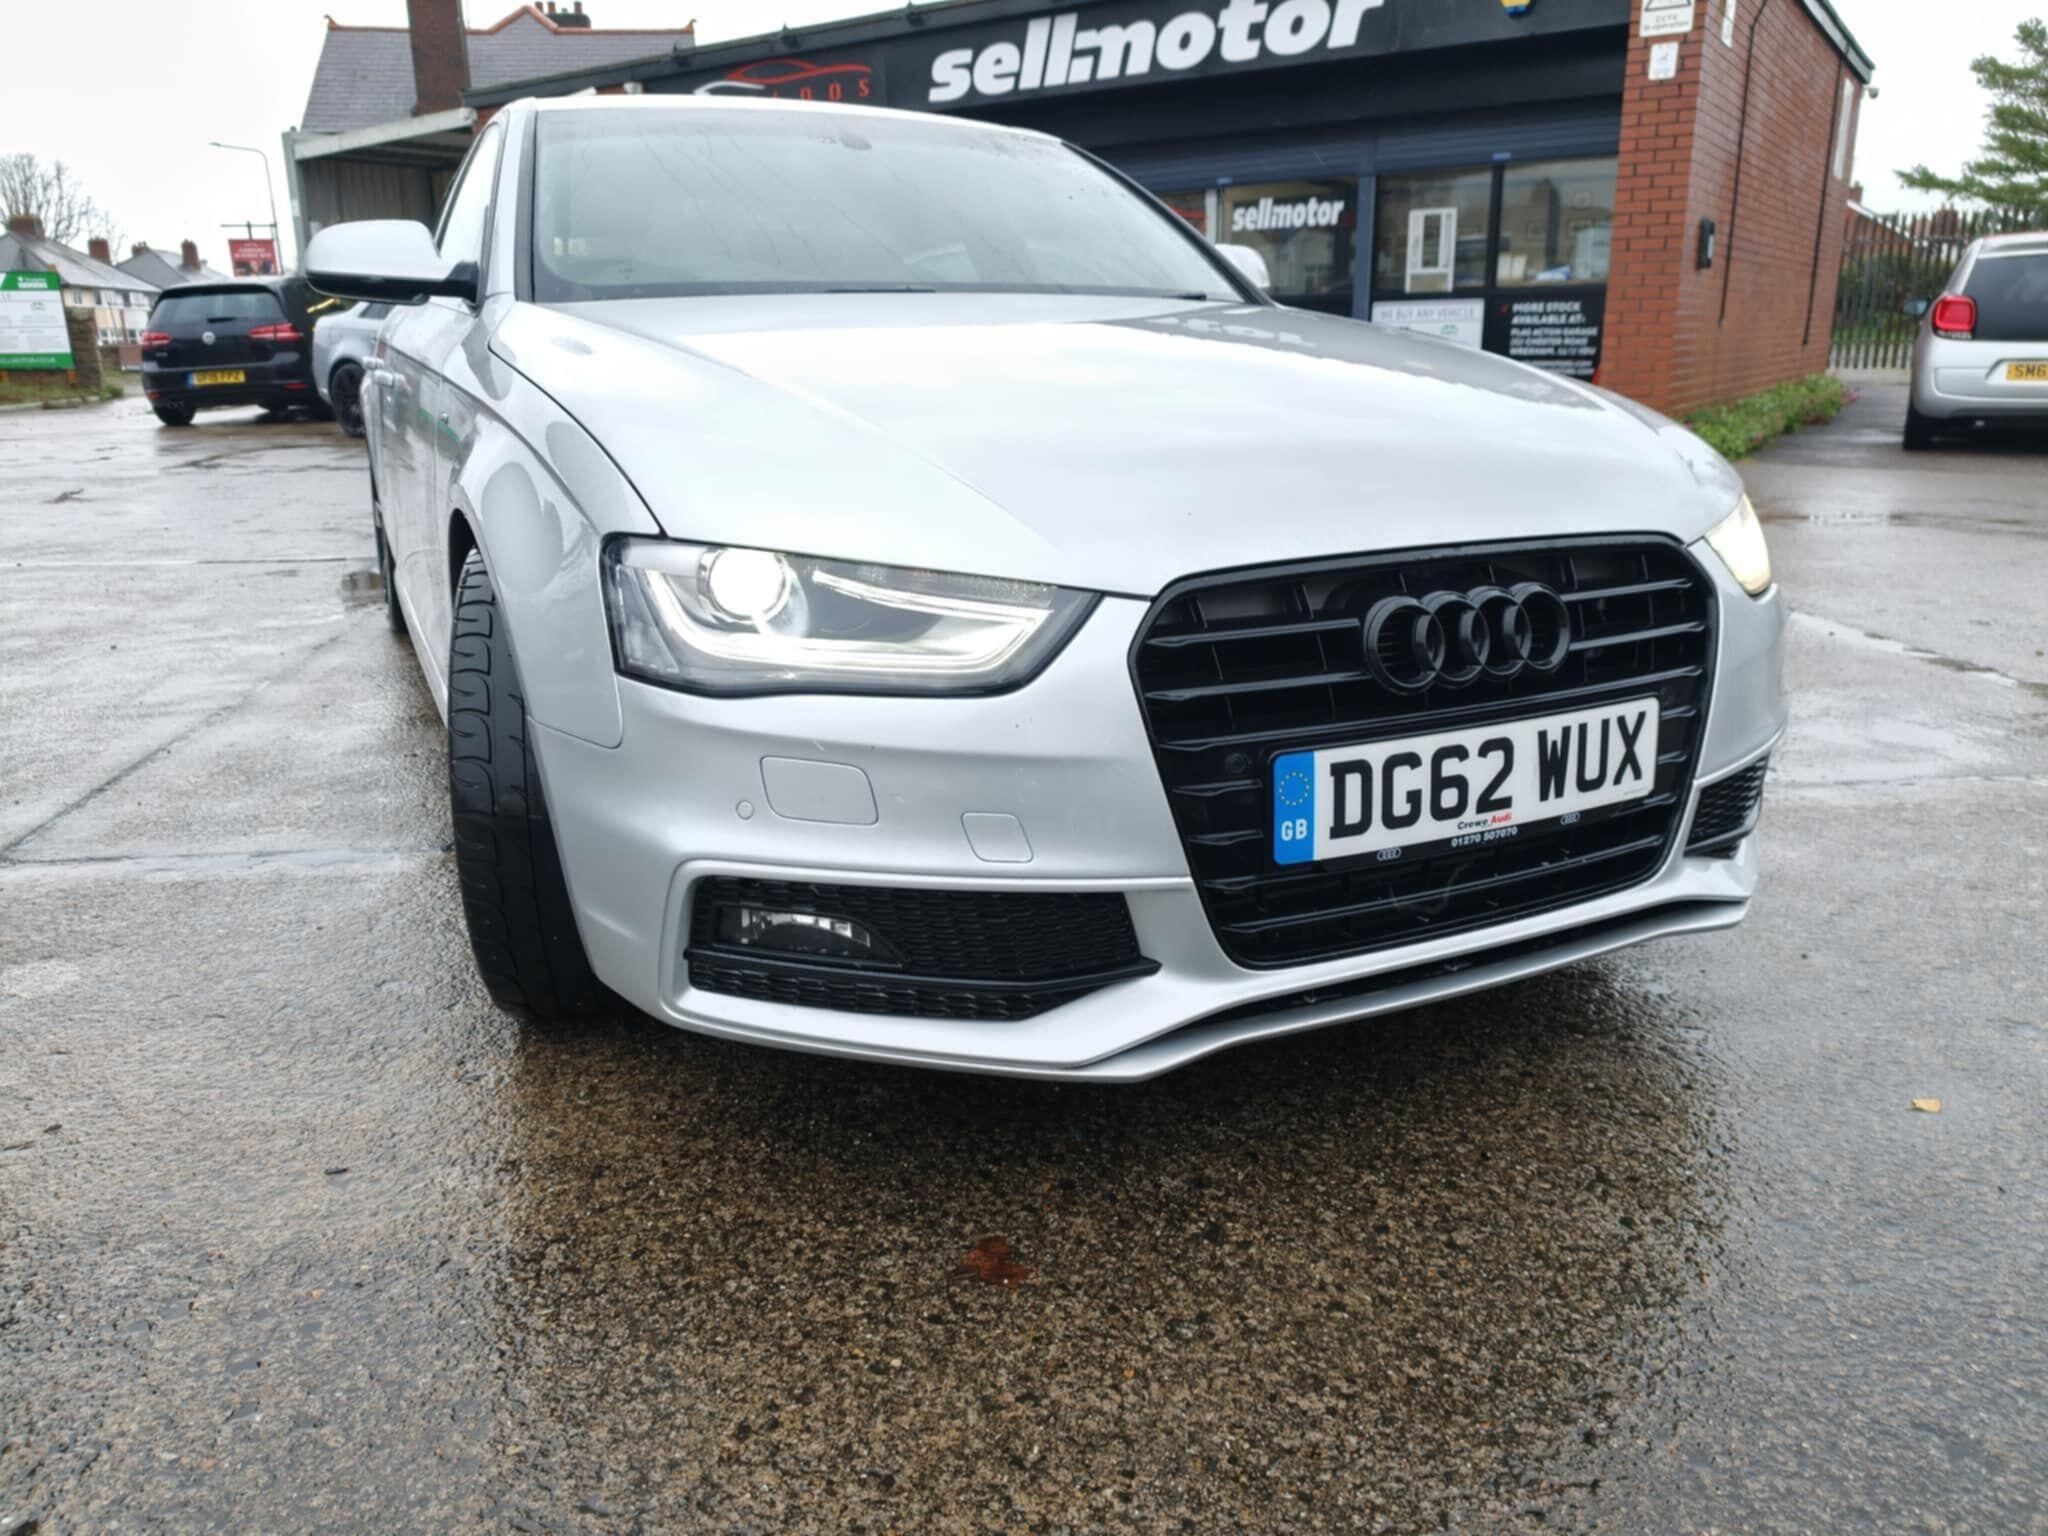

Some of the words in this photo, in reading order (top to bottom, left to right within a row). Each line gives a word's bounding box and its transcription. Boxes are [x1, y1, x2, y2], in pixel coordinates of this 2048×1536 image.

[928, 0, 1385, 103] sellmotor
[1231, 196, 1345, 232] sellmotor
[1512, 302, 1545, 313] MORE
[1546, 301, 1582, 312] STOCK
[1511, 313, 1567, 325] AVAILABLE
[1329, 736, 1515, 841] DG62
[1537, 711, 1647, 803] WUX
[1280, 818, 1307, 842] GB
[1457, 818, 1489, 830] Crewe
[1490, 812, 1512, 825] Audi
[1451, 833, 1482, 848] 01270
